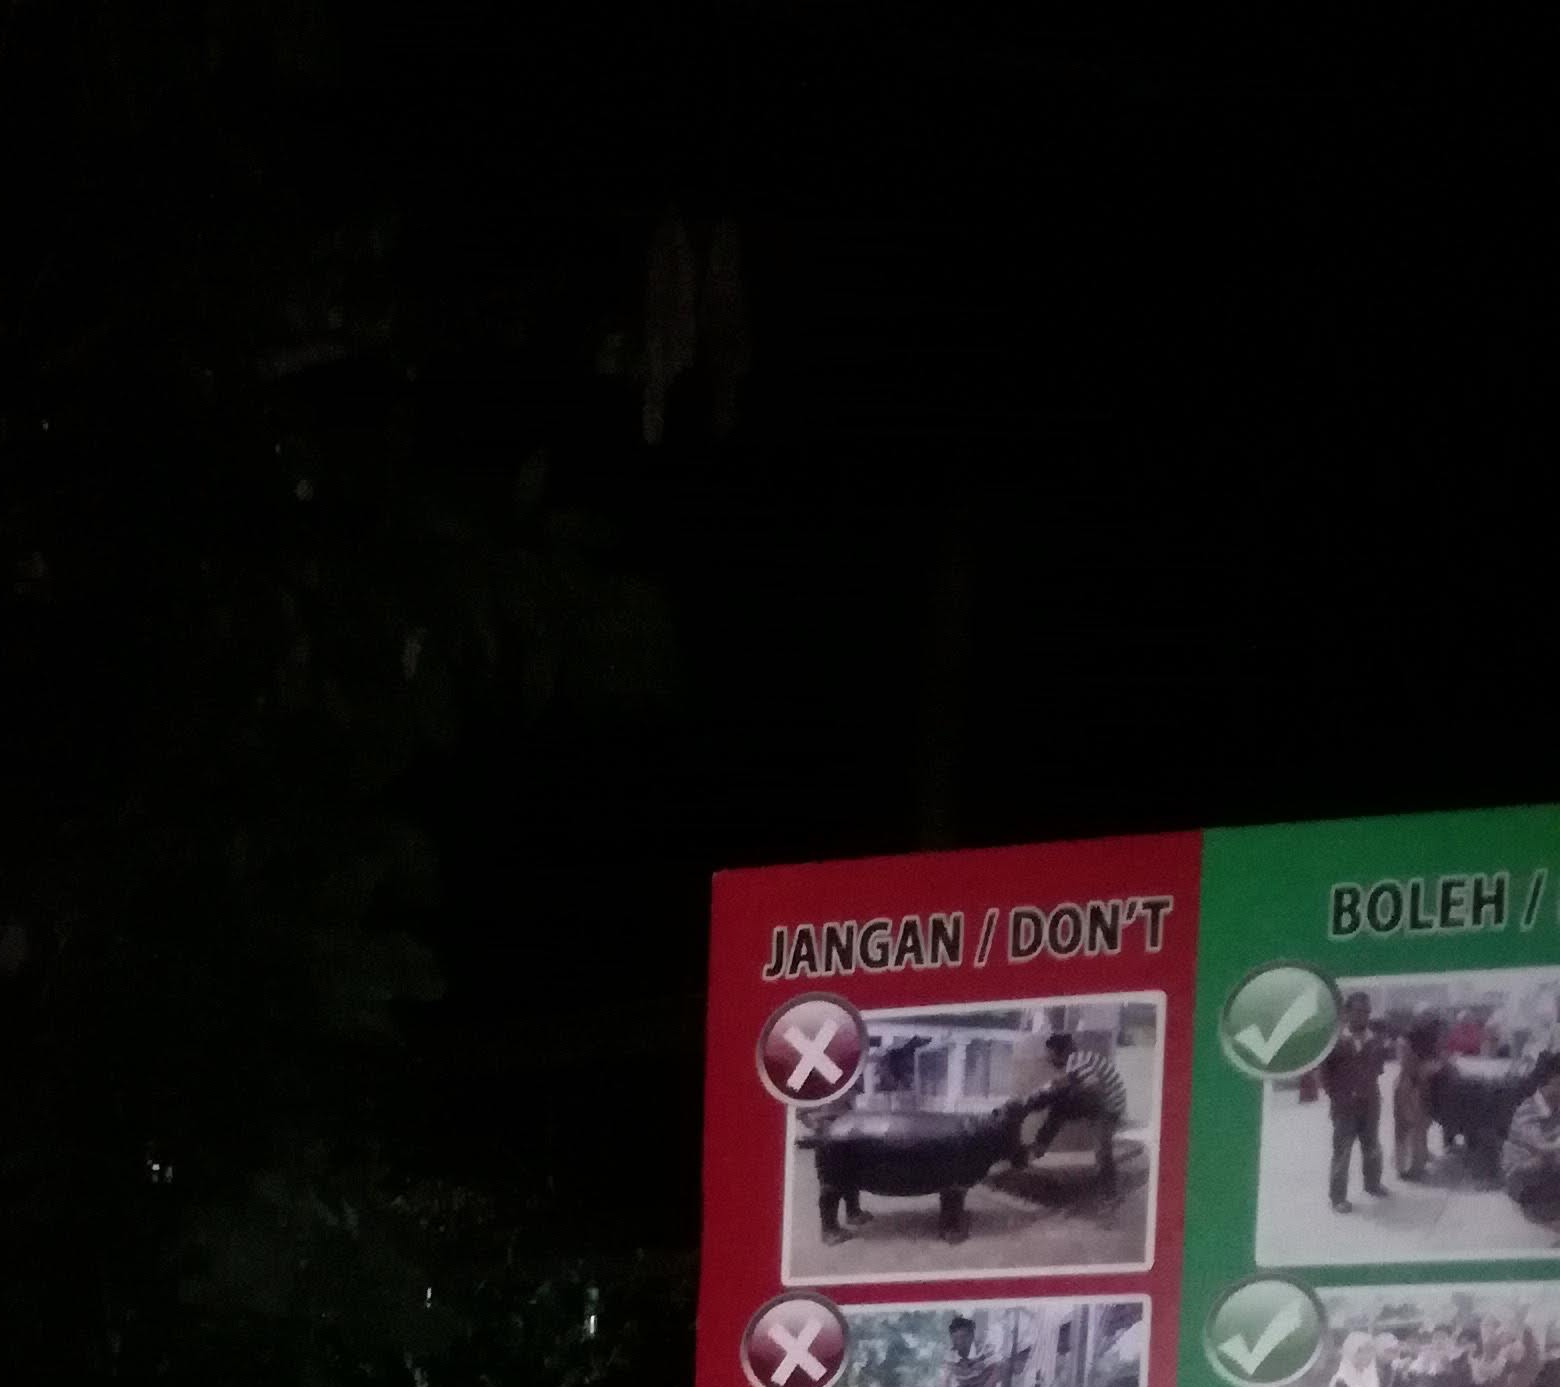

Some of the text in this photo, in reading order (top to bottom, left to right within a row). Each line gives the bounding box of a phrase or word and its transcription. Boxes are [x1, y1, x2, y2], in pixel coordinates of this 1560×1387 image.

[762, 896, 1175, 981] JANGAN / DON'T
[1328, 868, 1548, 940] BOLEH /
